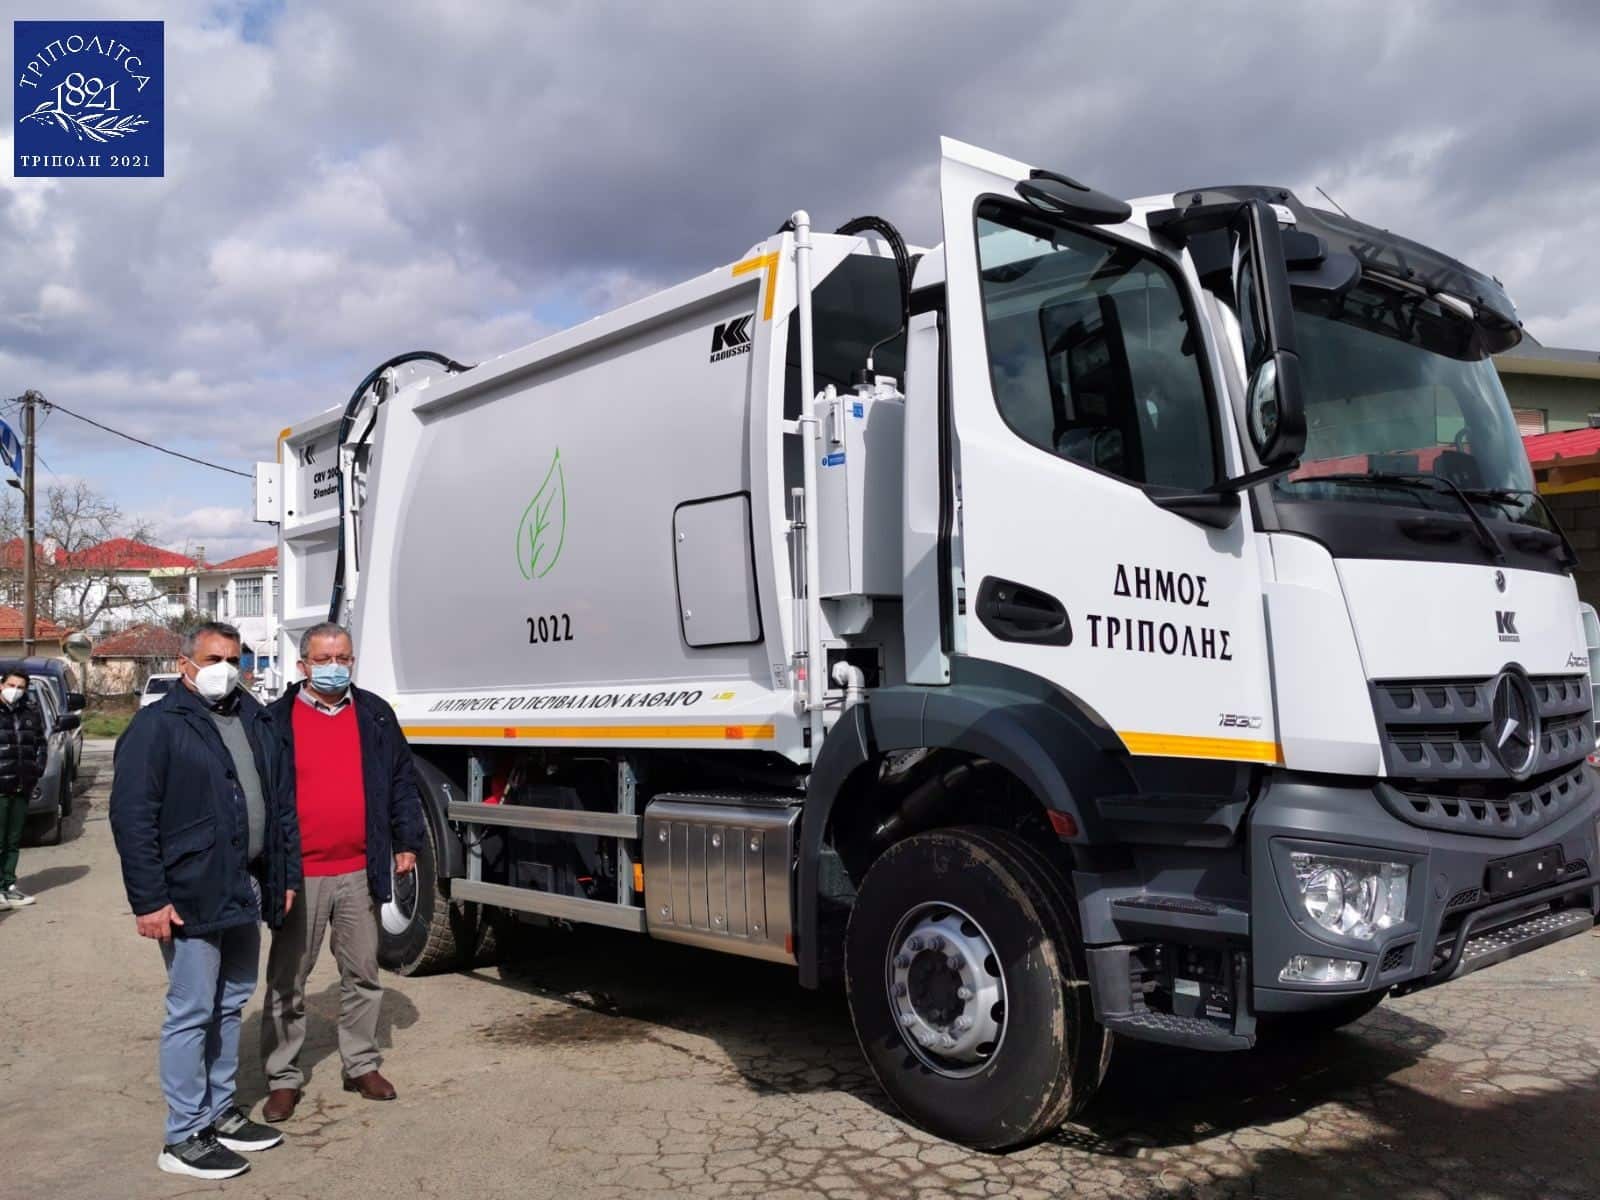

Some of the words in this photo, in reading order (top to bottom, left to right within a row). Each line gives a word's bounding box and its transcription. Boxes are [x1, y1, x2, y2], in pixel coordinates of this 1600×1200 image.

[709, 343, 752, 364] KAOUSSIS
[1113, 563, 1210, 608] ΔΗΜΟΣ
[526, 613, 574, 644] 2022
[1086, 614, 1233, 661] ΤΡΙΠΟΛΗΣ
[500, 696, 526, 711] ΤΟ
[521, 692, 626, 710] ΠΕΡΙΒΑΛΛΟΝ
[620, 690, 703, 708] ΚΑΘΑΡΟ
